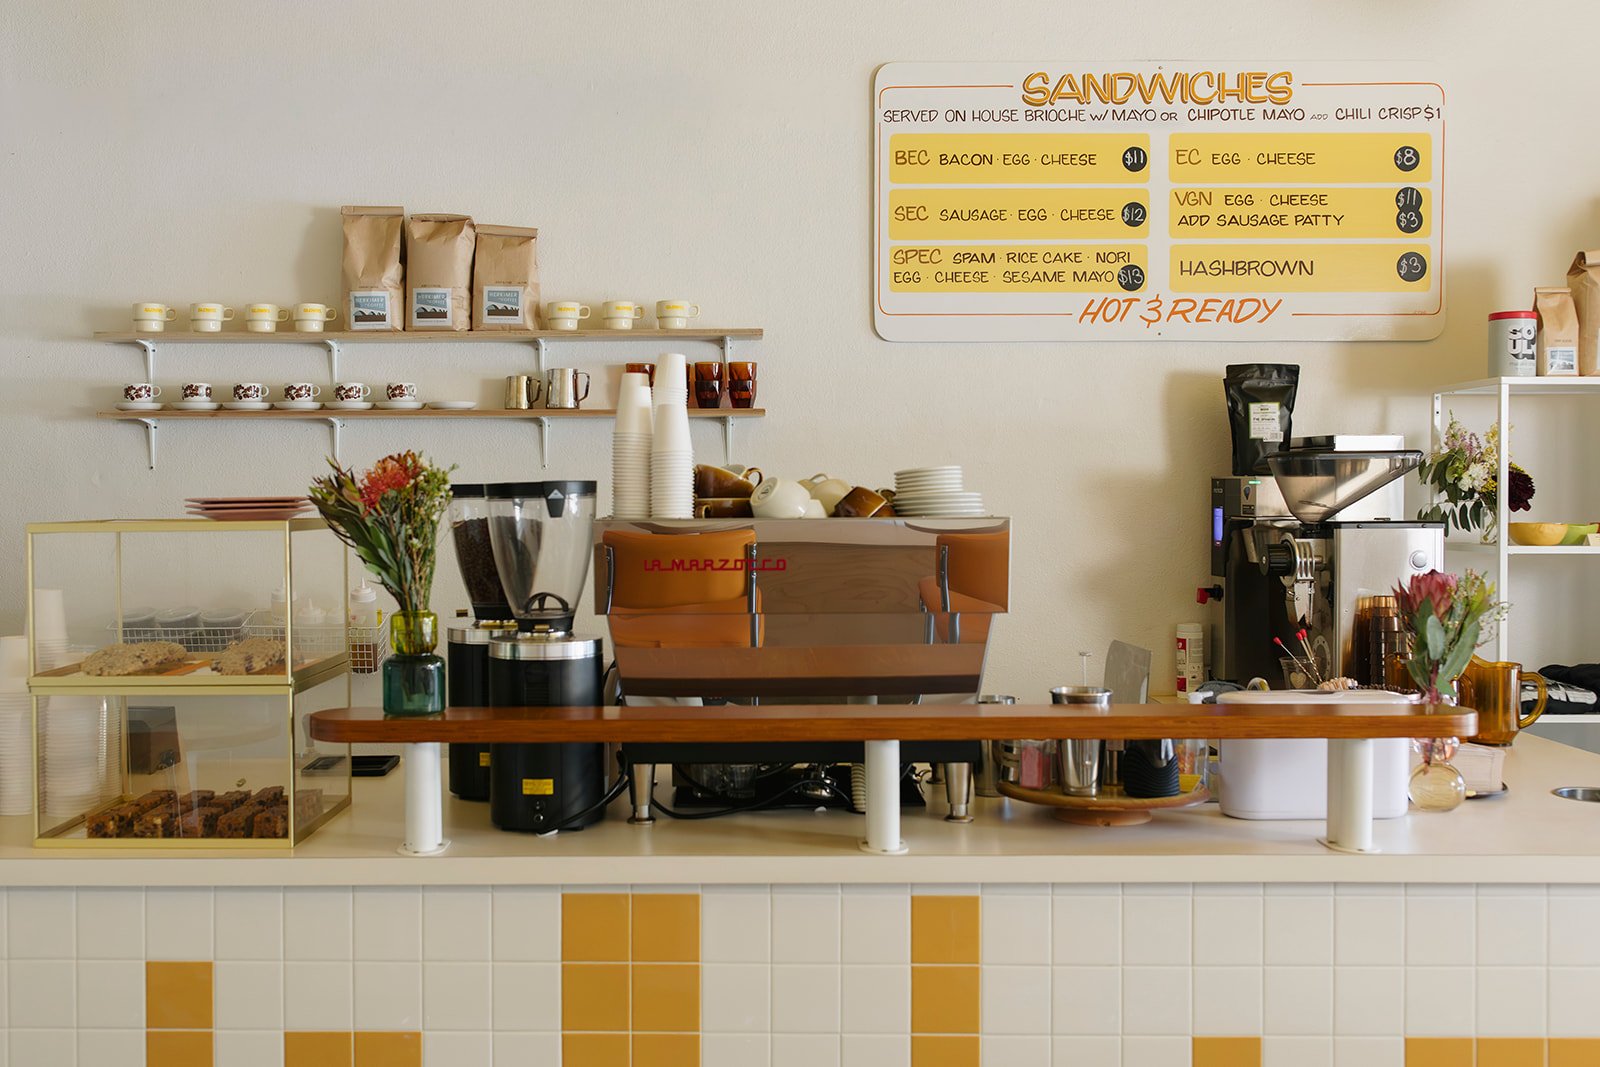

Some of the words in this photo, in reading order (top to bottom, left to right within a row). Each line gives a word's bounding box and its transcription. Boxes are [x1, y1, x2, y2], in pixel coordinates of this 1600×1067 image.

[1021, 71, 1294, 107] SANDWICHES
[883, 109, 939, 123] SERVED
[945, 109, 966, 123] ON
[972, 109, 1019, 122] HOUSE
[1024, 109, 1086, 122] BRIOCHE
[1111, 109, 1157, 122] MAYO
[1160, 112, 1178, 122] OR
[1187, 108, 1255, 122] CHIPOTLE
[1262, 108, 1306, 121] MAYO
[1309, 113, 1329, 121] ADD
[1335, 107, 1372, 121] CHILI
[895, 149, 931, 166] BEC
[939, 153, 993, 166] BACON
[1002, 153, 1031, 166] EGG
[1040, 153, 1097, 166] CHEESE
[1124, 151, 1144, 167] $11
[1175, 148, 1202, 166] EC
[1211, 152, 1241, 166] EGG
[1256, 152, 1316, 166] CHEESE
[1397, 148, 1417, 166] $8
[1174, 191, 1213, 207] VGN
[1224, 194, 1255, 207] EGG
[1269, 194, 1329, 207] CHEESE
[894, 205, 929, 222] SEC
[939, 209, 1008, 222] SAUSAGE
[1018, 209, 1048, 221] EGG
[1060, 208, 1115, 221] CHEESE
[1122, 207, 1144, 223] $12
[1177, 214, 1211, 227] ADD
[1216, 214, 1289, 227] SAUSAGE
[1294, 214, 1345, 227] PATTY
[1399, 212, 1419, 228] $3
[893, 248, 943, 265] SPEC
[952, 252, 996, 264] SPAM
[1006, 252, 1038, 264] RICE
[1042, 251, 1083, 264] CAKE
[1095, 251, 1131, 264] NORI
[1179, 260, 1314, 276] HASHBROWN
[1399, 256, 1422, 277] $3
[893, 272, 922, 284] EGG
[934, 271, 989, 284] CHEESE
[1002, 271, 1066, 283] SESAME
[1072, 271, 1115, 283] MAYO
[1118, 267, 1145, 285] $13
[1078, 297, 1140, 325] HOT
[1166, 298, 1283, 324] READY
